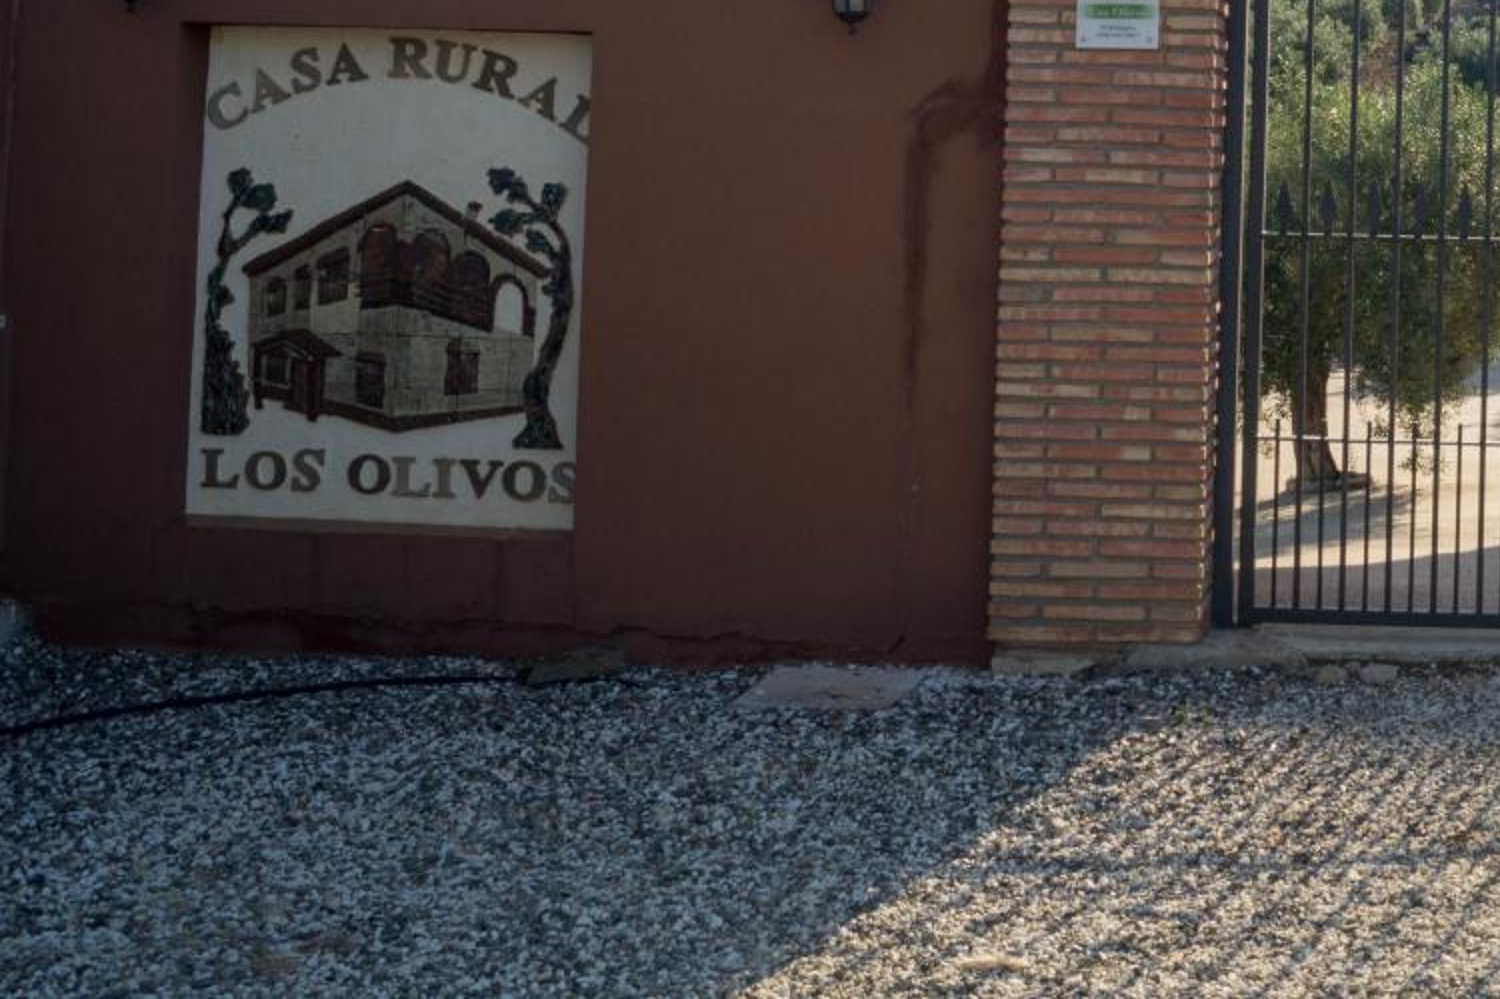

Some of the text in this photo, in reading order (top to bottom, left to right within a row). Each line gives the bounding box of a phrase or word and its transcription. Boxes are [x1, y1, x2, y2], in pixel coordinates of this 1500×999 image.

[207, 36, 592, 147] CASA RURAL
[201, 447, 577, 505] LOS OLIVOS
